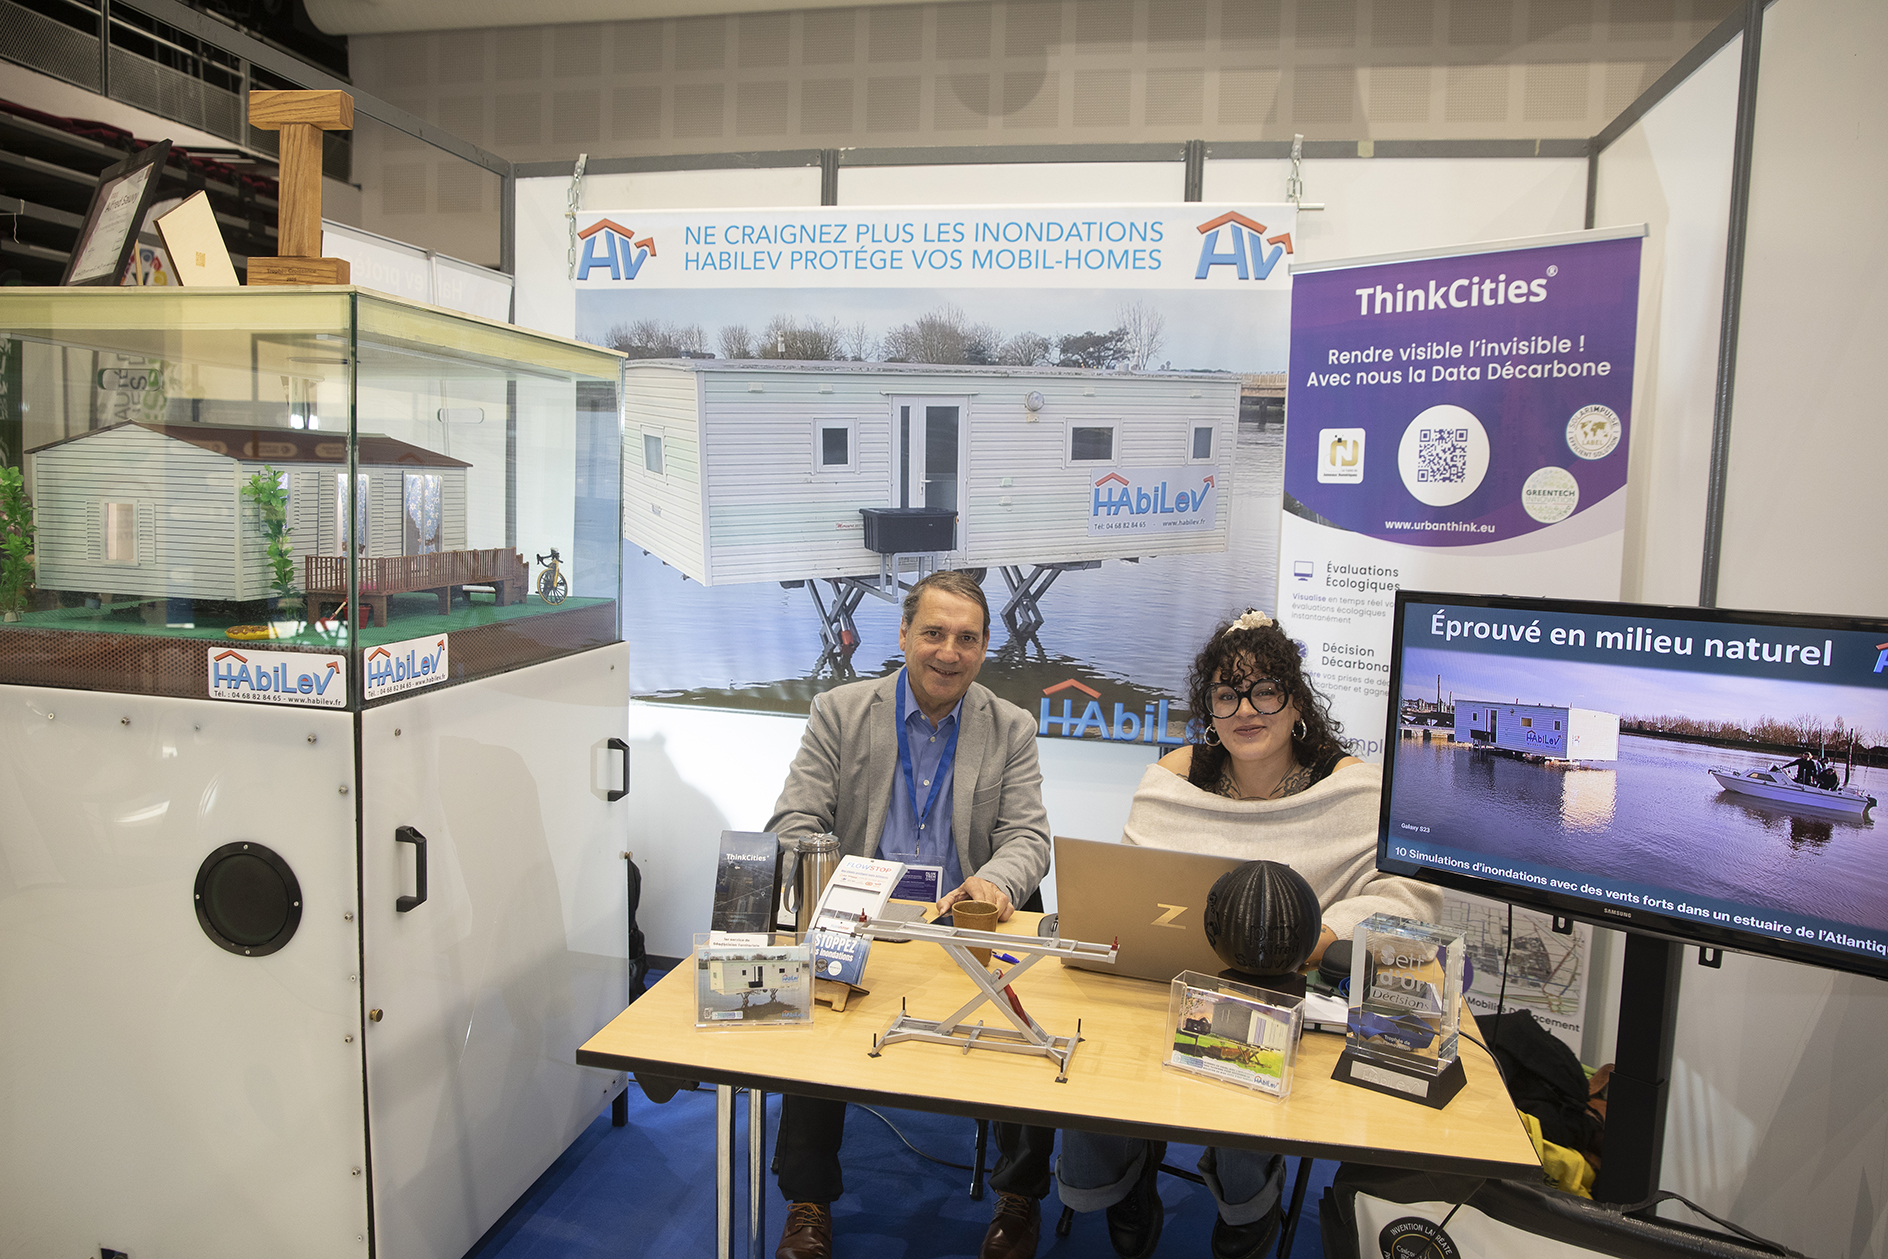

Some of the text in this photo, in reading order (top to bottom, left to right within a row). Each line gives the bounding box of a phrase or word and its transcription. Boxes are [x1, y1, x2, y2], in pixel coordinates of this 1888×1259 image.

[685, 221, 1164, 245] NE CRAIGNEZ PLUS LES INONDATIONS
[685, 246, 1163, 271] HABILEV PROTÉGE VOS MOBIL-HOMES
[1328, 334, 1585, 365] Rendre visible l’invisible !
[1306, 360, 1612, 388] Avec nous la Data Décarbone
[1569, 436, 1592, 458] EFFICIENT
[1526, 489, 1576, 497] GREENTECH
[1131, 521, 1138, 529] 84
[1385, 519, 1496, 534] www.urbanthink.eu
[1327, 561, 1400, 578] Évaluations
[1326, 574, 1401, 593] Écologiques
[1292, 593, 1327, 602] Visualise
[1340, 597, 1366, 607] temps
[1367, 598, 1383, 607] réel
[1291, 602, 1387, 618] évaluations écologiques
[1291, 611, 1352, 625] instantanément
[1431, 608, 1833, 667] Éprouvé en milieu naturel
[1322, 642, 1375, 657] Décision
[1321, 656, 1390, 673] Décarbona
[1322, 672, 1336, 680] vos
[1337, 673, 1362, 684] prises
[1363, 677, 1375, 685] de
[386, 686, 393, 694] 68
[1353, 685, 1362, 693] et
[231, 691, 241, 699] 04
[241, 692, 251, 700] 68
[251, 692, 261, 700] 82
[262, 693, 272, 701] 84
[272, 694, 282, 702] 65
[288, 695, 342, 706] www.habilev.fr
[1400, 822, 1431, 834] Galaxy S23
[726, 853, 767, 862] ThinkCities
[846, 861, 893, 874] FLOWSTOP
[1395, 846, 1888, 957] 10 Simulations d'inondations avec des vents forts dans un estuaire de l’Atlantiq
[1603, 907, 1632, 918] SAMSUNG
[1249, 920, 1300, 946] prix
[814, 933, 858, 954] STOPPEZ
[1259, 942, 1300, 955] Alfred
[1234, 953, 1295, 971] Sauvy
[1380, 944, 1428, 973] Sett
[1372, 988, 1430, 1011] Décisions
[1389, 1222, 1424, 1237] INVENTION
